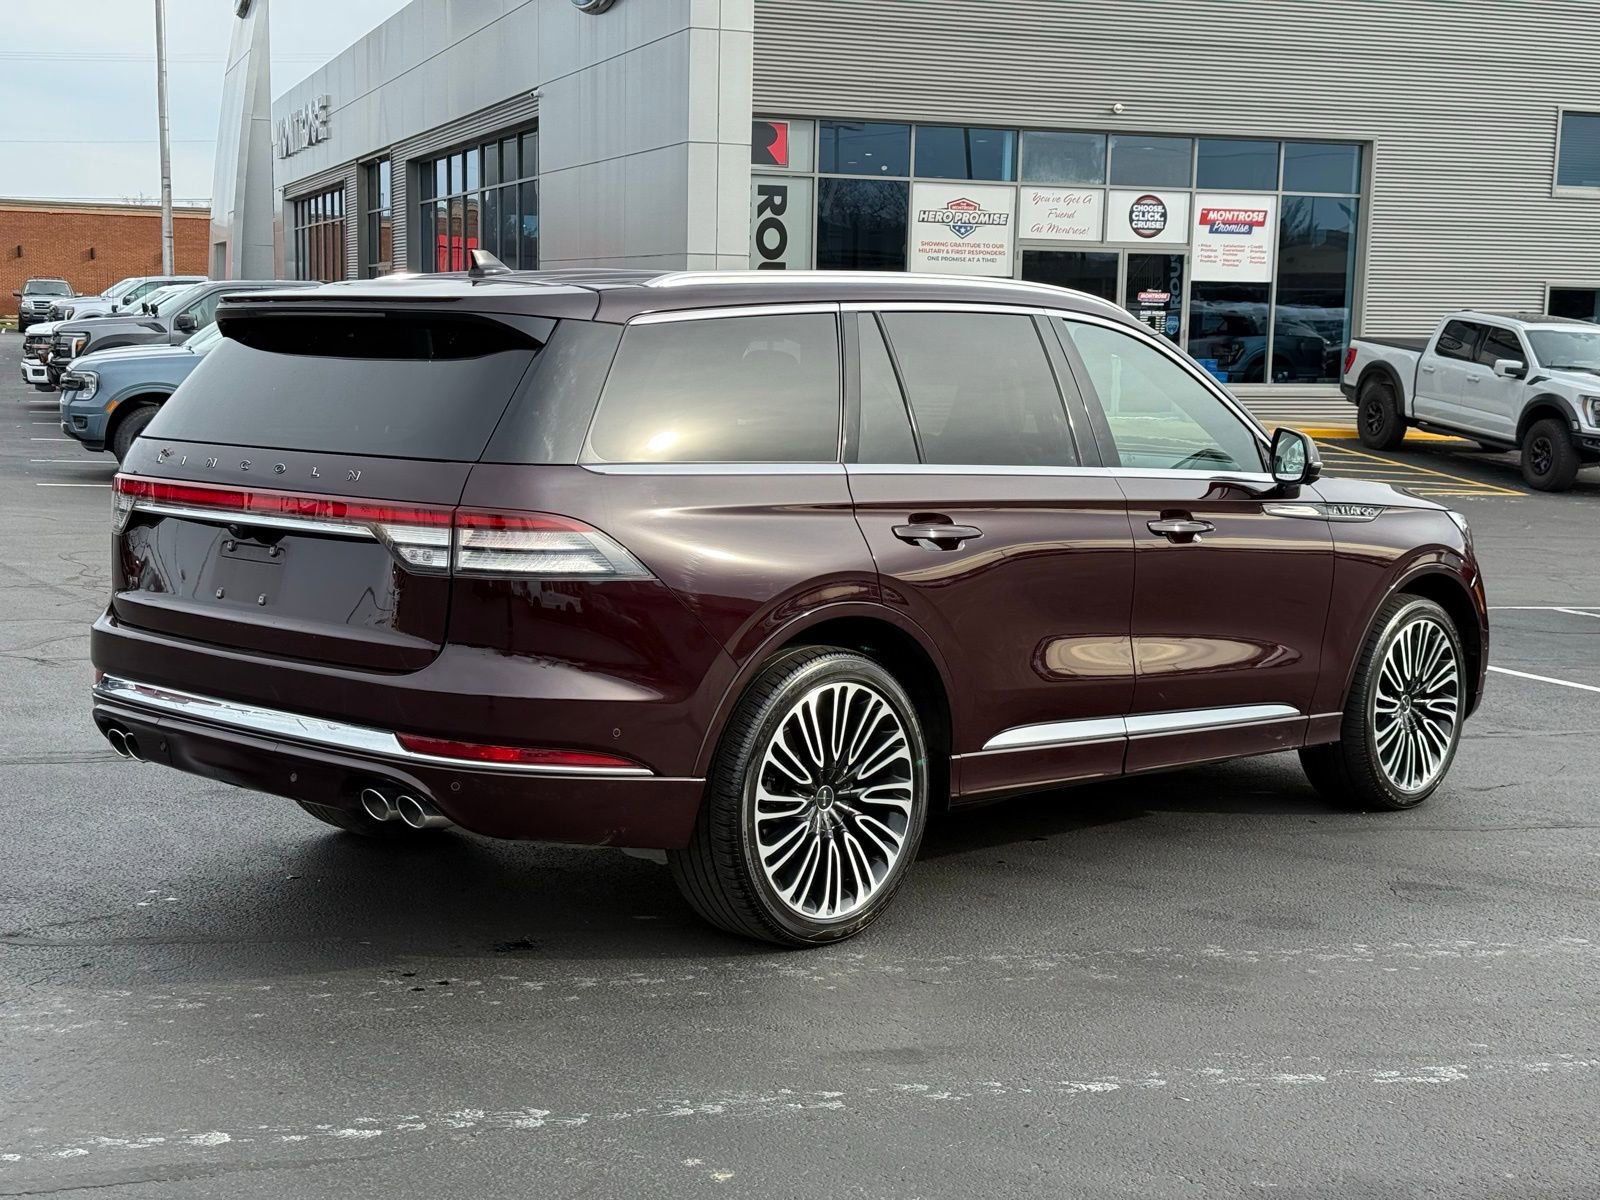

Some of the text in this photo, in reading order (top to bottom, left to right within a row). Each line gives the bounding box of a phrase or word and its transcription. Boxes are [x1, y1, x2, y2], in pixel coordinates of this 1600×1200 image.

[1032, 192, 1061, 205] You've
[1063, 193, 1080, 206] Got
[919, 210, 1008, 225] HERO PROMISE
[1048, 208, 1077, 219] Friend
[1132, 211, 1165, 221] CLICK.
[1207, 210, 1265, 222] MONTROSE
[756, 184, 787, 270] RO
[1046, 222, 1090, 234] Montrose!
[1212, 221, 1250, 233] Promise
[156, 453, 361, 482] LINCOLN
